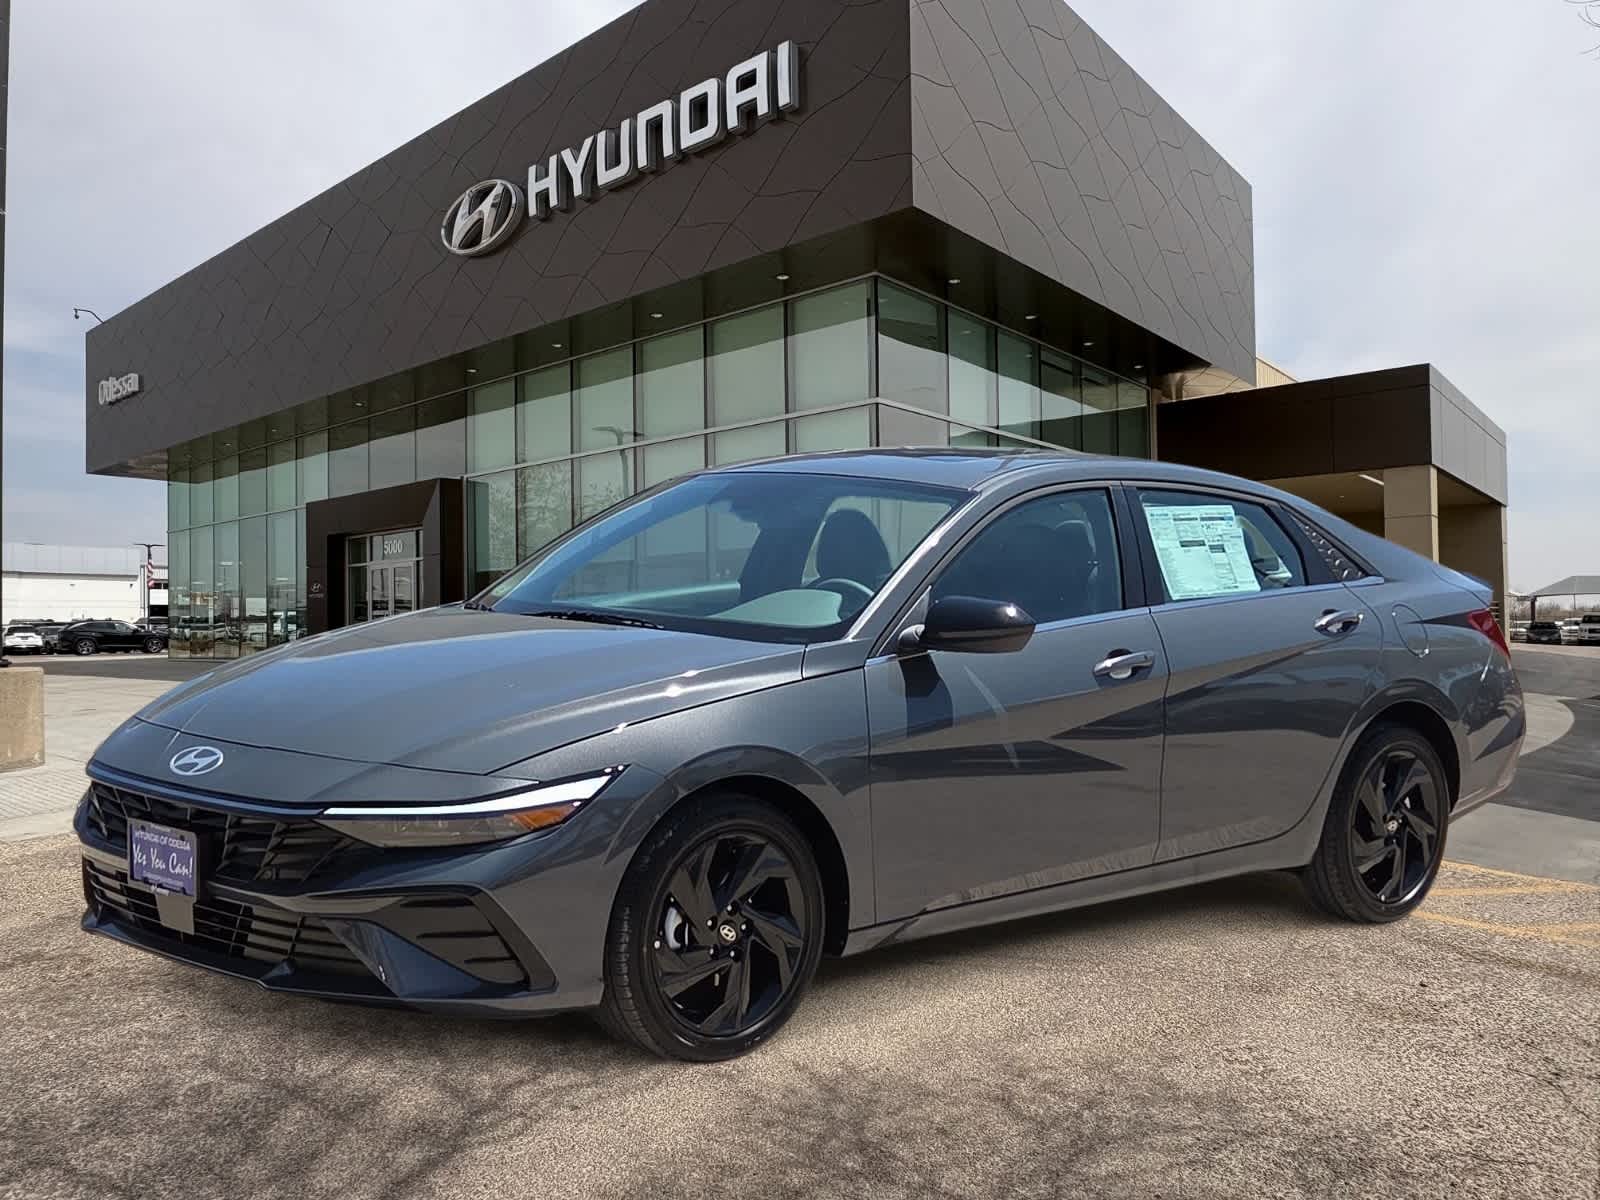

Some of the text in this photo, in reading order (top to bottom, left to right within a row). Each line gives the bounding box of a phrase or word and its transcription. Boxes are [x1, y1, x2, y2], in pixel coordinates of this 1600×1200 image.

[528, 40, 797, 218] HYUNDAI
[384, 540, 403, 554] 5000
[133, 843, 193, 878] Yes You Can!
